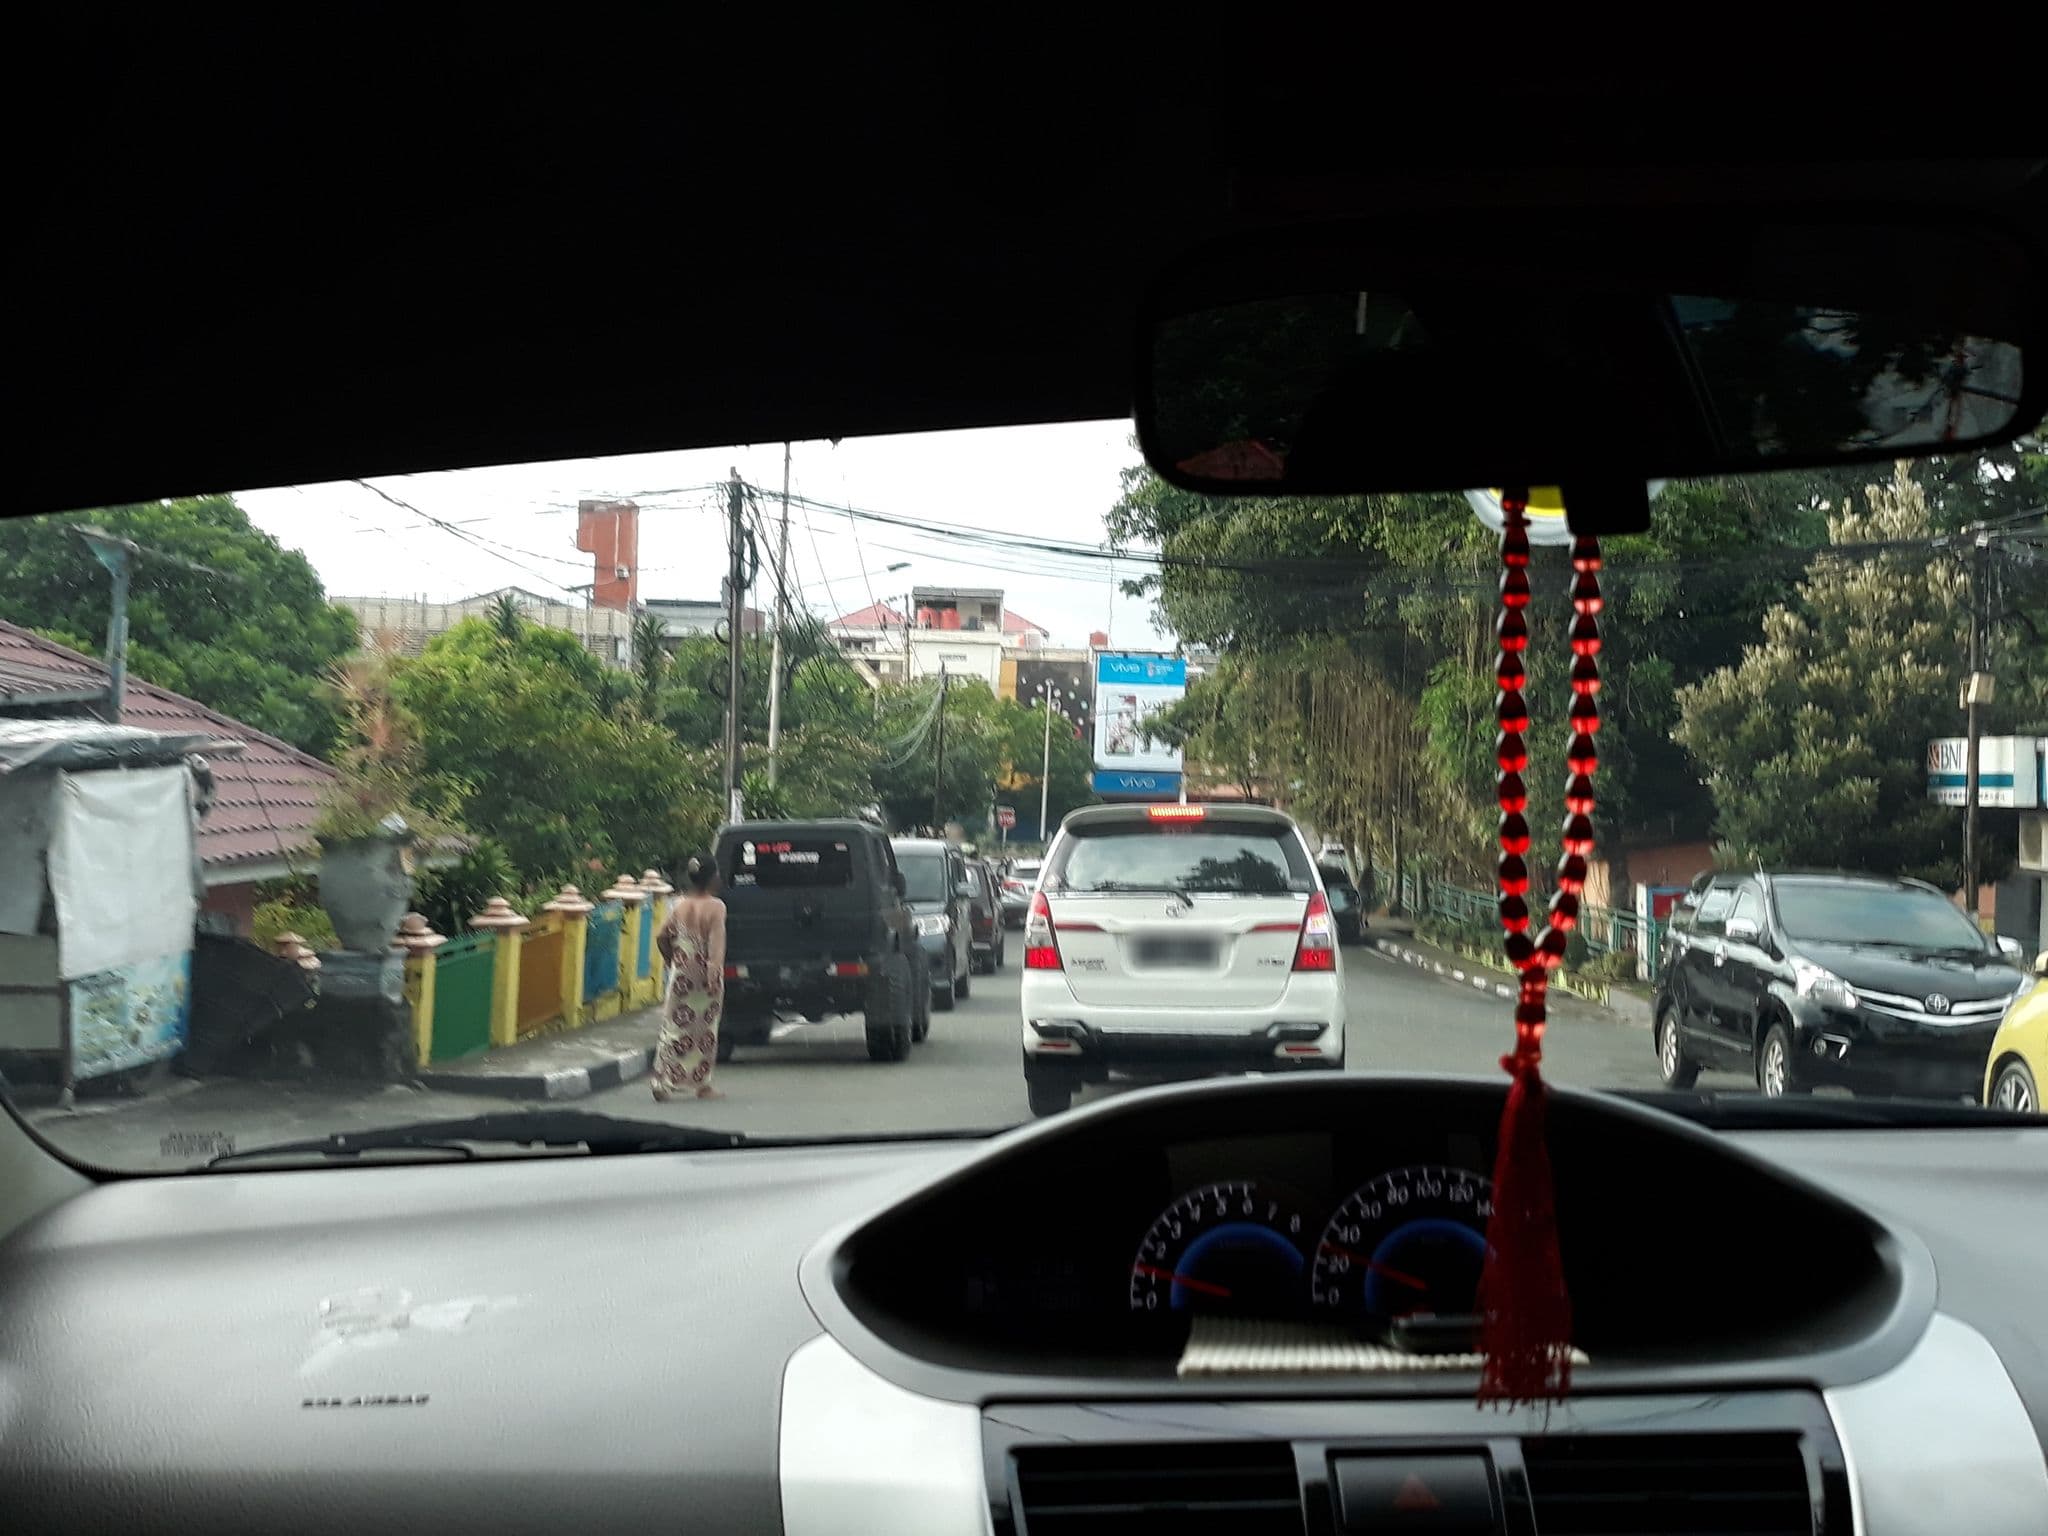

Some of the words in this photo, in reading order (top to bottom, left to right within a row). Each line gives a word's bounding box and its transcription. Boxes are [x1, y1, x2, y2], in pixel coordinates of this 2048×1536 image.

[1941, 743, 1961, 769] BNI
[1387, 1186, 1409, 1205] 80
[1416, 1179, 1442, 1198] 100
[1449, 1183, 1474, 1203] 120
[1360, 1200, 1382, 1219] 60
[1338, 1224, 1361, 1244] 40
[1146, 1290, 1157, 1310] 0
[1156, 1240, 1167, 1260] 2
[1170, 1220, 1182, 1240] 3
[1190, 1203, 1201, 1223] 4
[1216, 1196, 1227, 1216] 5
[1242, 1198, 1253, 1216] 6
[1268, 1200, 1278, 1221] 7
[1290, 1213, 1300, 1233] 8
[1328, 1253, 1350, 1273] 20
[1328, 1286, 1340, 1307] 0
